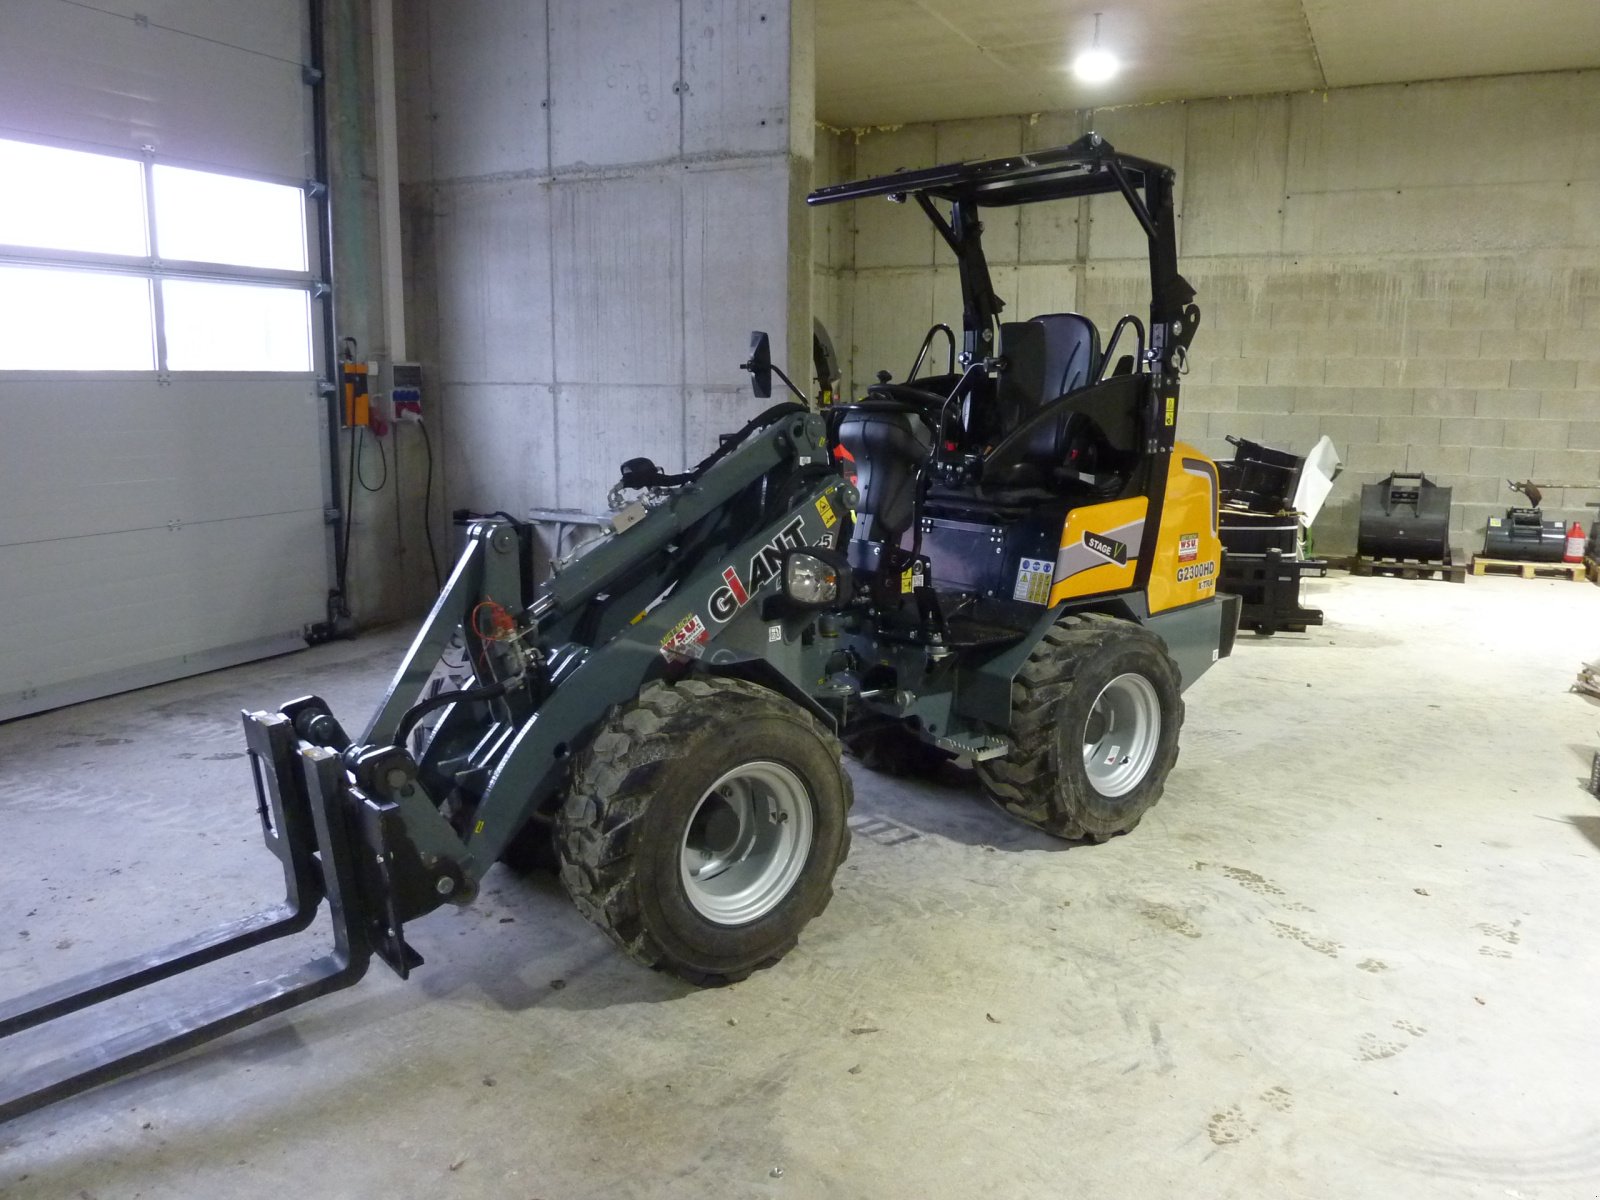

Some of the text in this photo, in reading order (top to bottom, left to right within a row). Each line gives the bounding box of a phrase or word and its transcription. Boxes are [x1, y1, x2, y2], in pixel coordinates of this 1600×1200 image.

[1088, 537, 1125, 559] STAGE V
[1176, 561, 1215, 583] G2300HD
